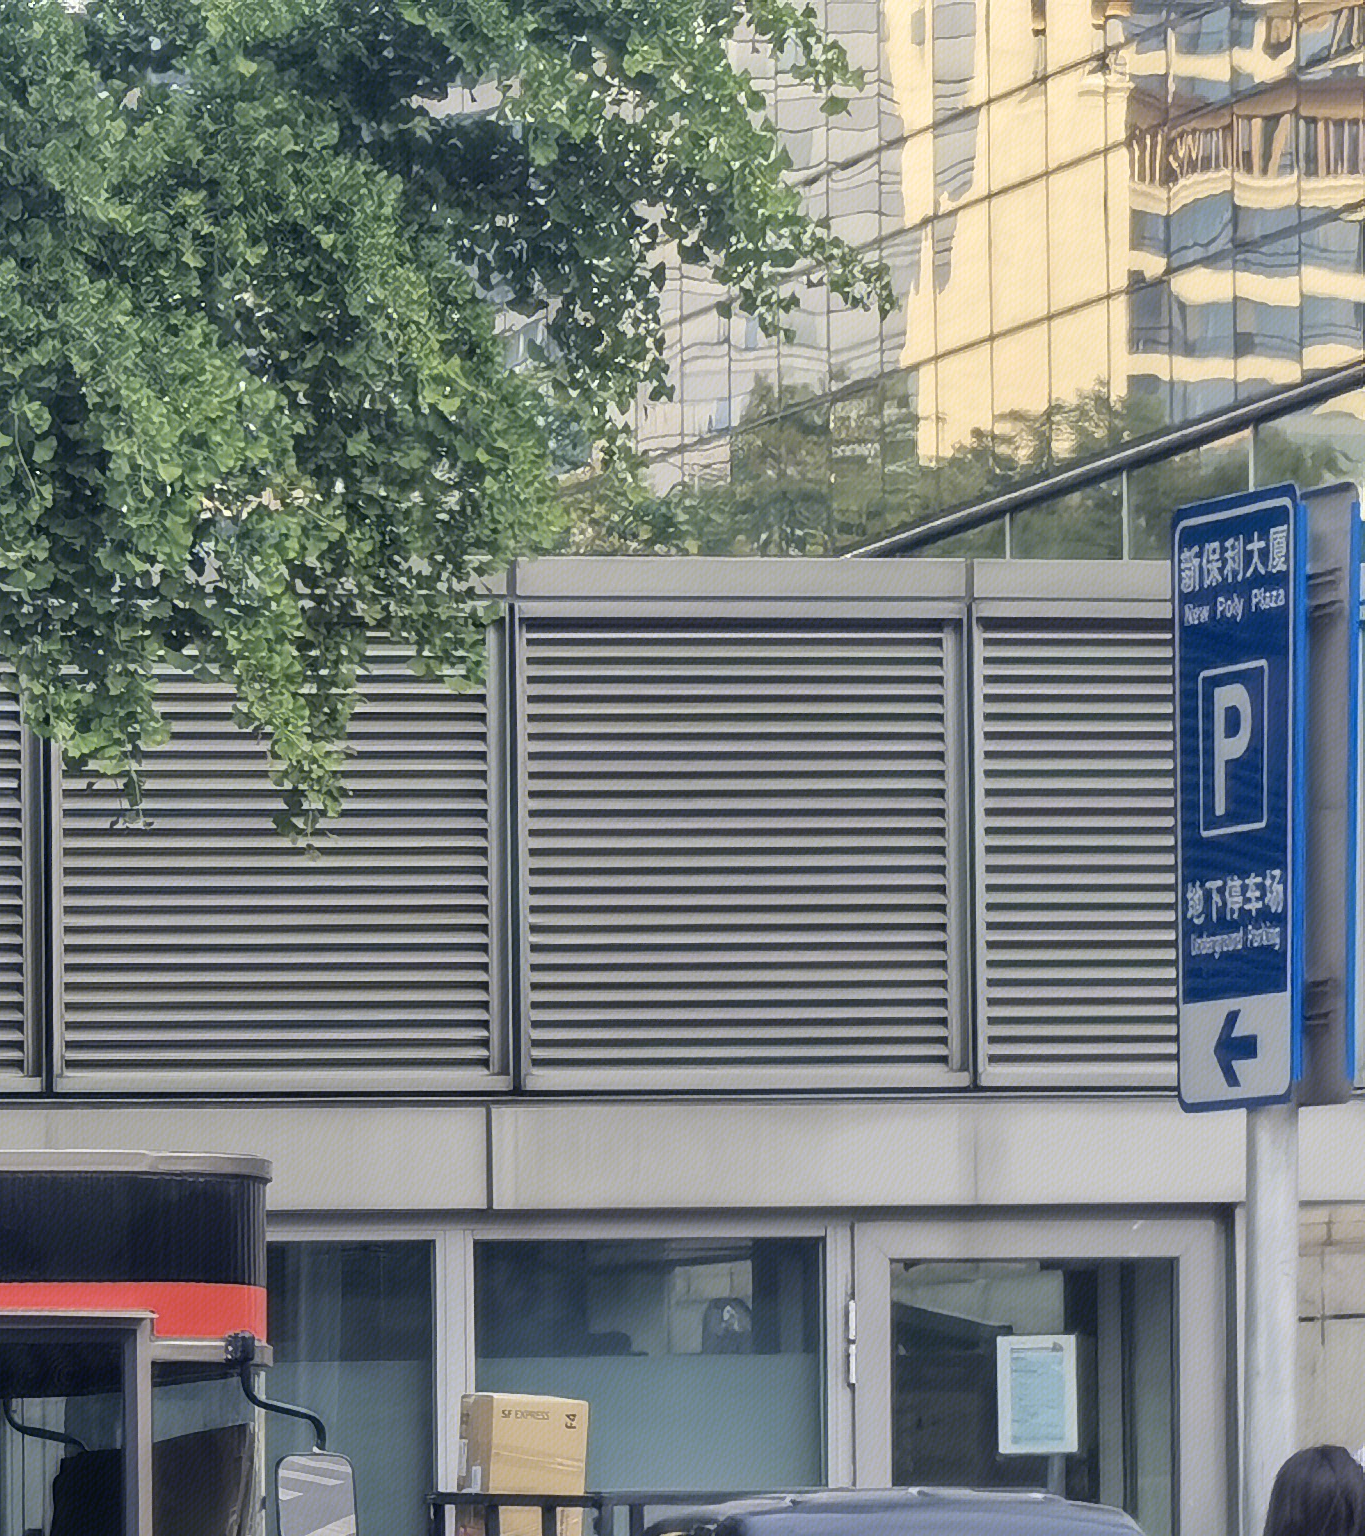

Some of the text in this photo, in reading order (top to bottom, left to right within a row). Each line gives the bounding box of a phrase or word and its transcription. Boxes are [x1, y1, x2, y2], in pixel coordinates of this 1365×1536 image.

[1180, 524, 1288, 593] 新保利大厦
[1183, 587, 1285, 626] New Poly Plaza
[1212, 681, 1253, 816] P
[1186, 868, 1284, 925] 地下停车场
